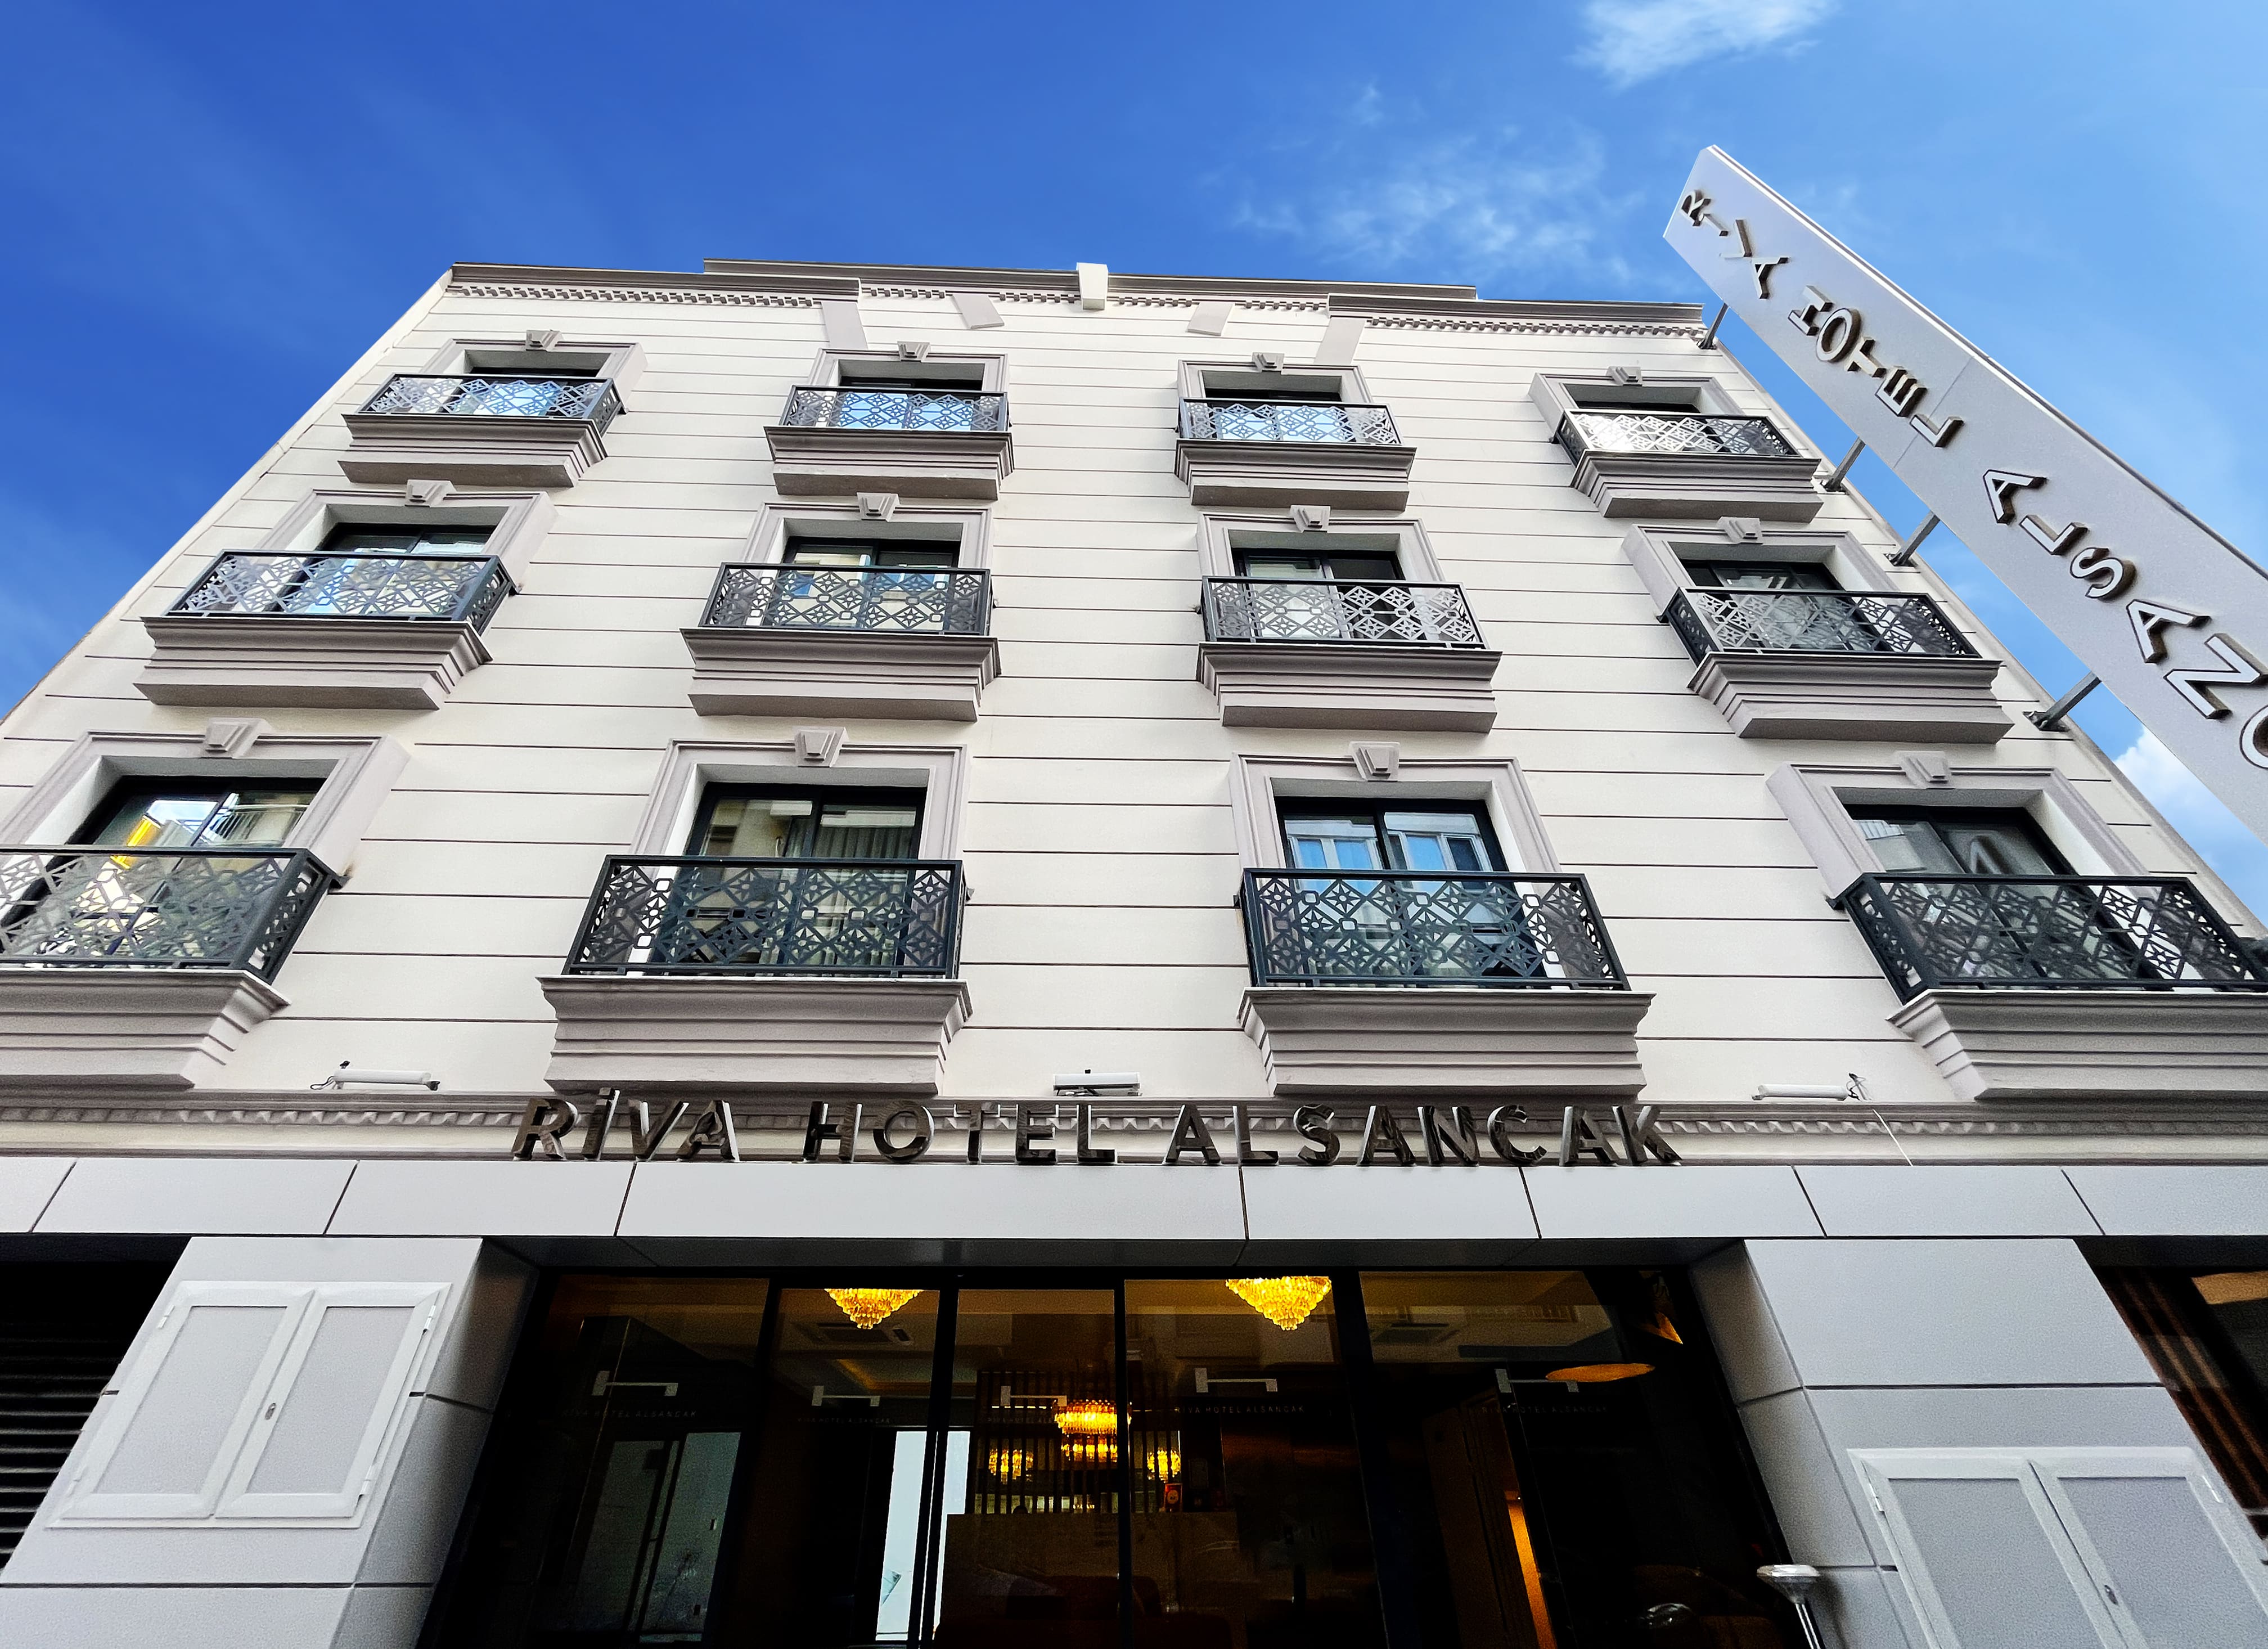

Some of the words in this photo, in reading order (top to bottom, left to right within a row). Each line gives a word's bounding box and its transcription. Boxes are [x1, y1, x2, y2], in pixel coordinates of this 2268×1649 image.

[1787, 285, 1964, 448] HOTEL
[801, 1100, 1118, 1164] HOTEL
[1162, 1102, 1682, 1166] ALSANCAK
